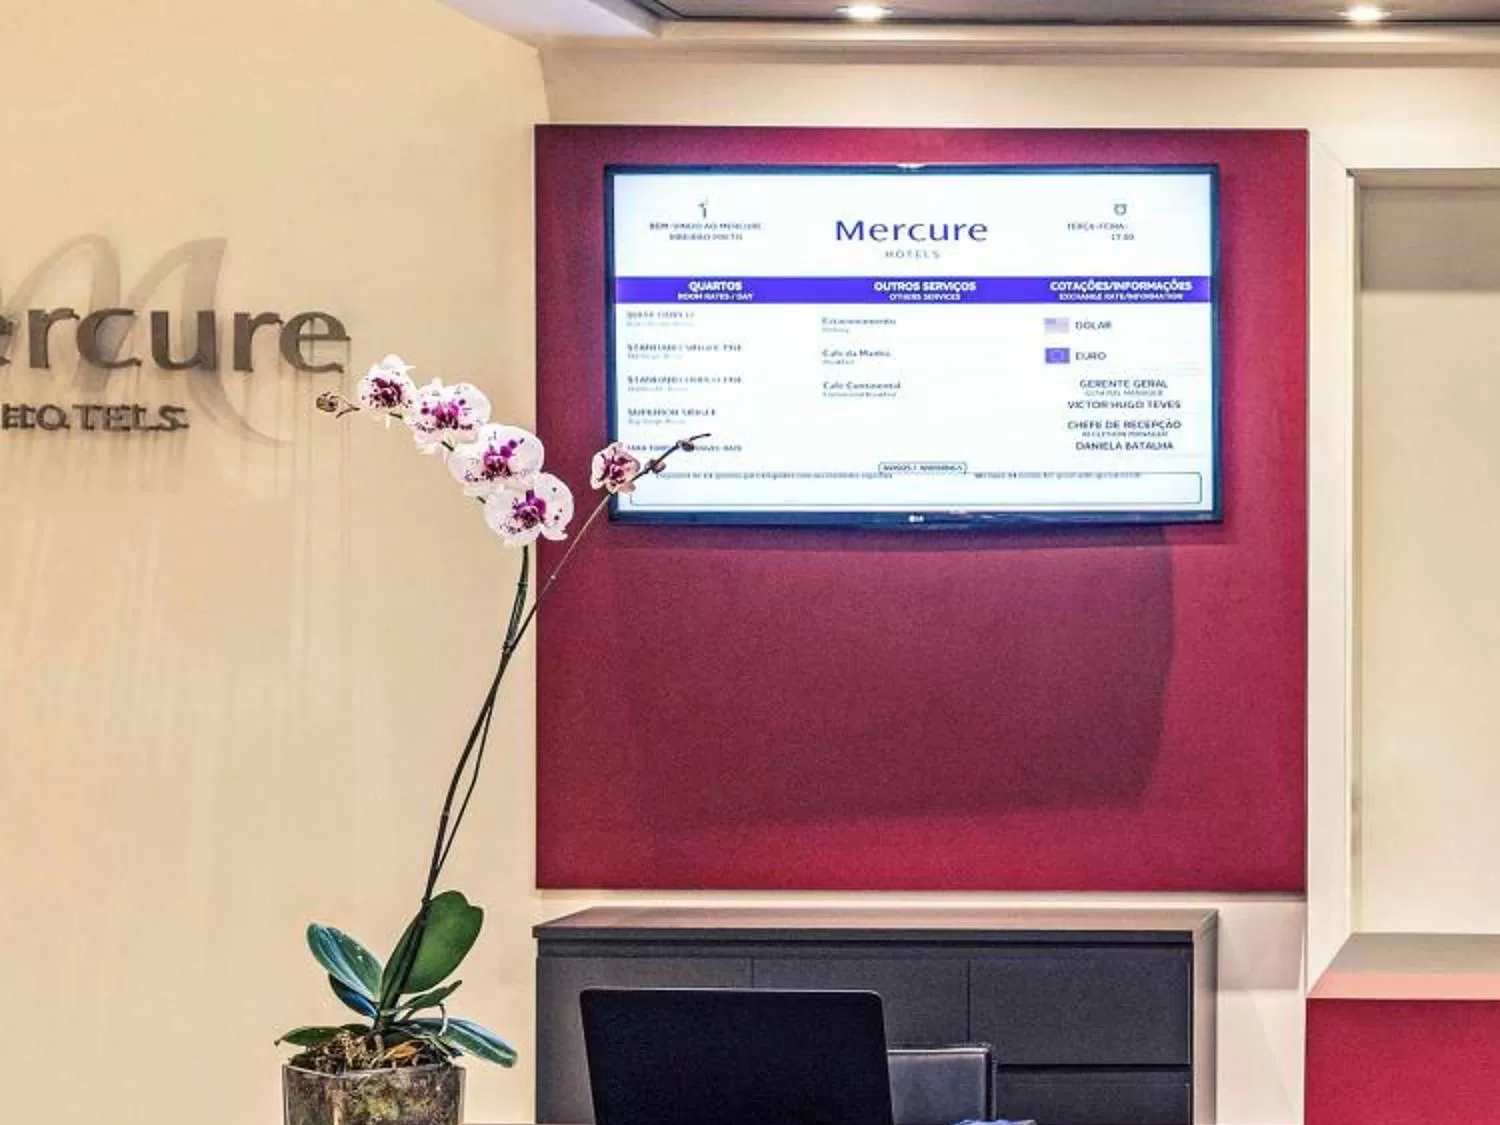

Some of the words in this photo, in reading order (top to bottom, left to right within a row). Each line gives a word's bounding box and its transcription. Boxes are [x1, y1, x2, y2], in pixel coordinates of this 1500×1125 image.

[835, 219, 988, 242] Mercure
[885, 250, 940, 259] HOTELS
[688, 281, 743, 292] QUARTOS
[873, 281, 920, 292] OUTROS
[922, 281, 977, 292] SERVIÇOS
[1050, 279, 1193, 292] COTAÇÕES/INFORMAÇÕES
[0, 308, 351, 373] rcure
[1079, 379, 1130, 388] GERENTE
[1133, 379, 1169, 388] GERAL
[2, 403, 189, 432] HOTELS
[1067, 419, 1102, 430] CHEFE
[1105, 419, 1121, 430] DE
[1075, 442, 1123, 451] DANIELA
[1125, 442, 1174, 451] BATALHA
